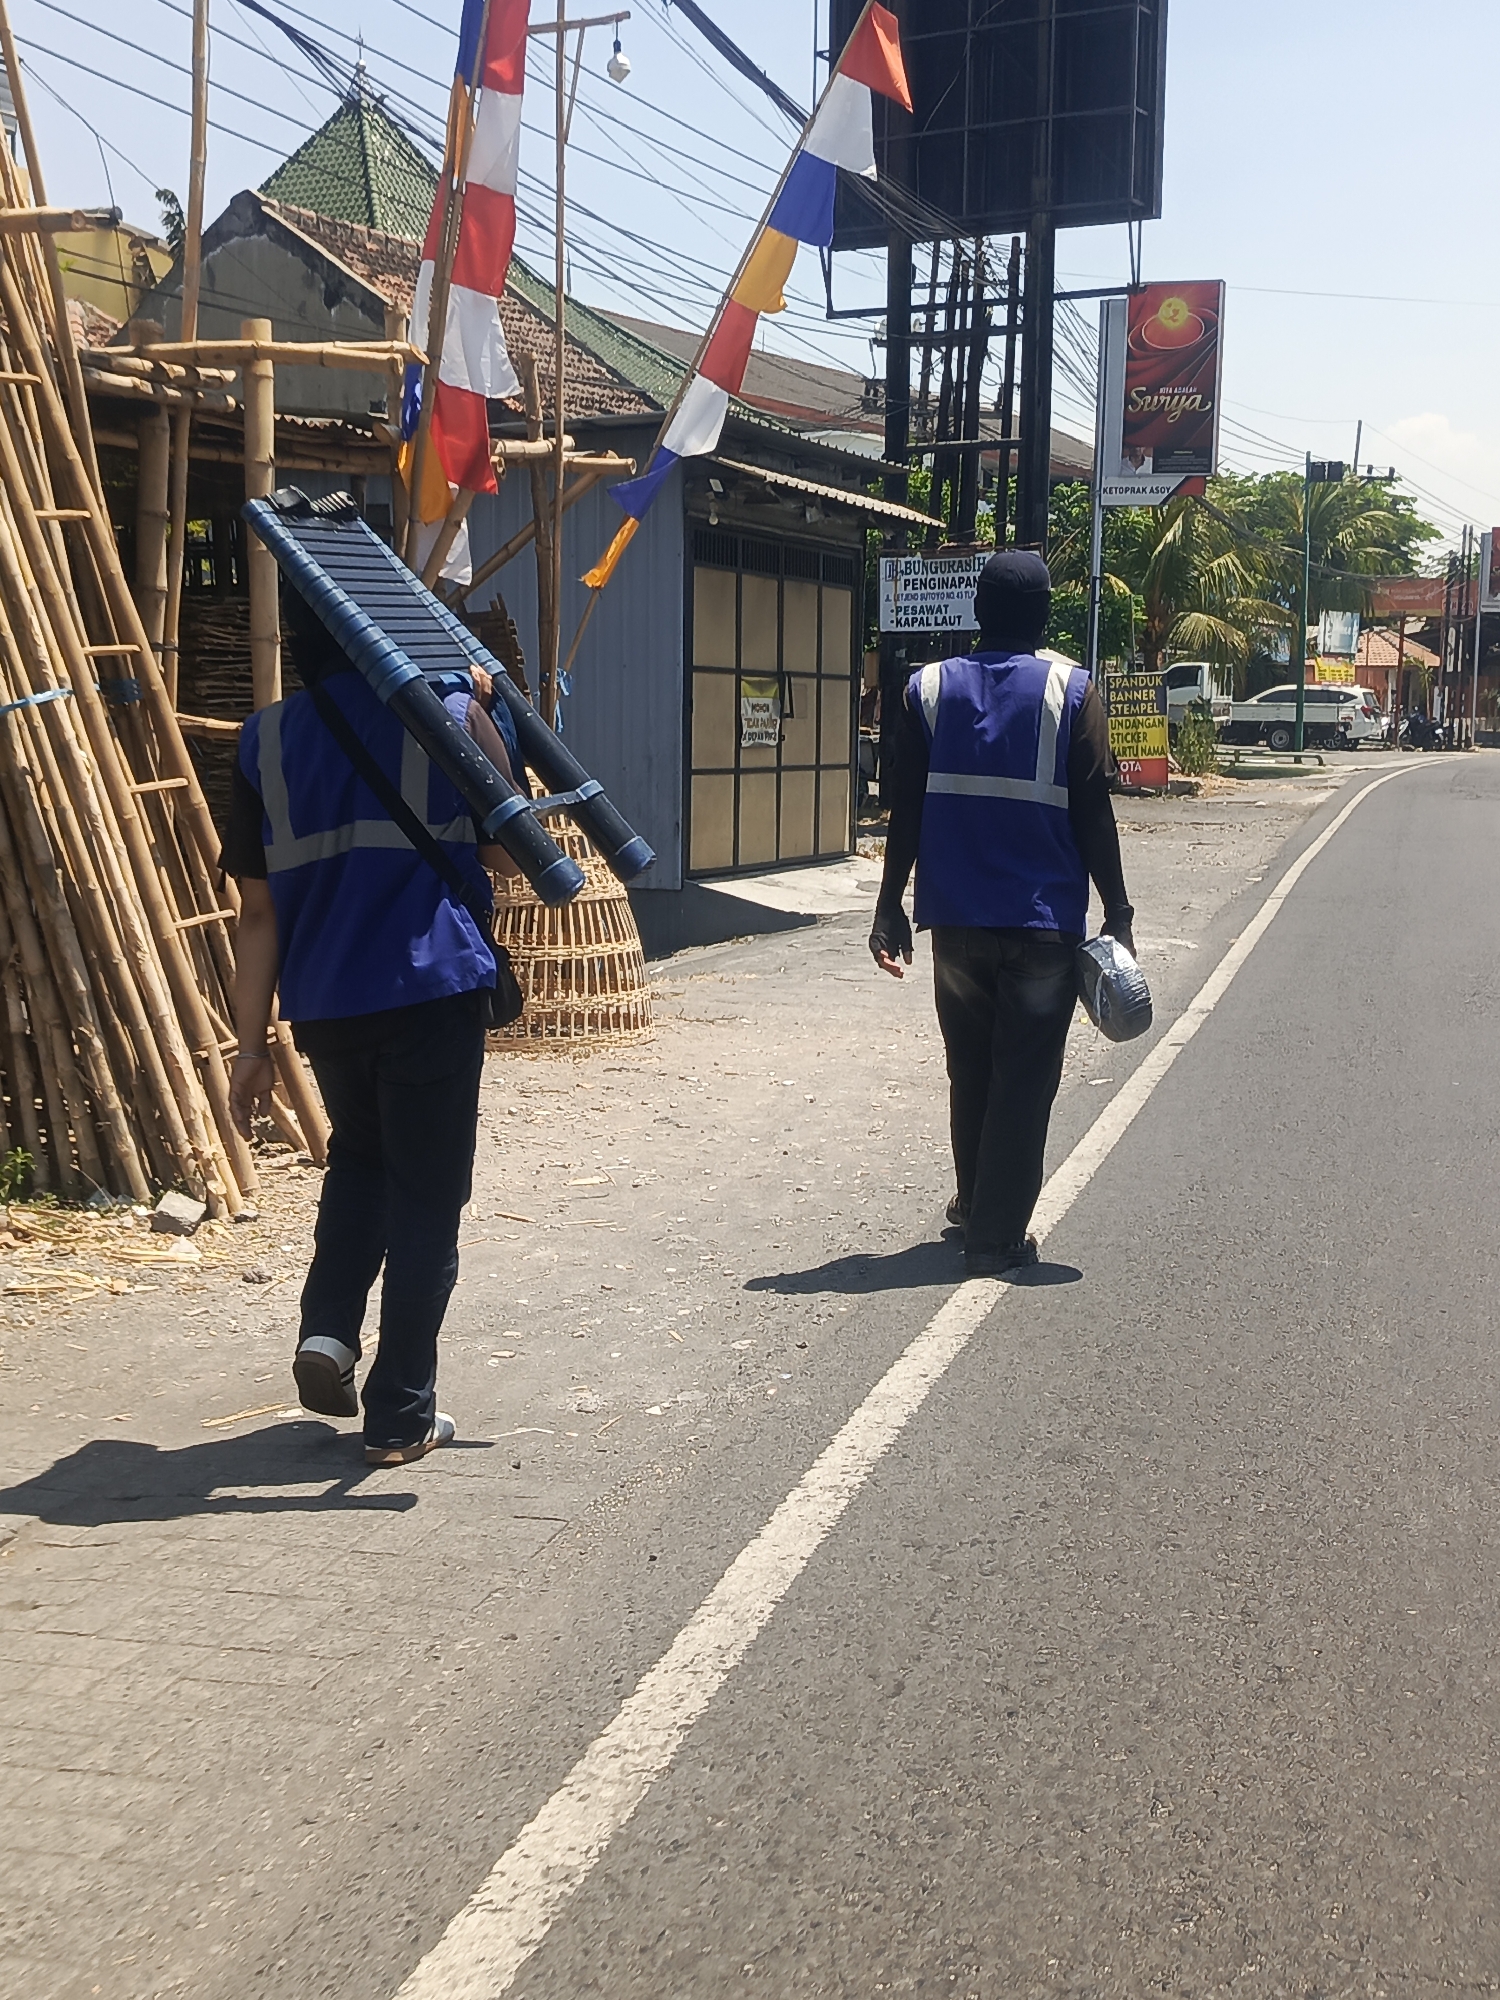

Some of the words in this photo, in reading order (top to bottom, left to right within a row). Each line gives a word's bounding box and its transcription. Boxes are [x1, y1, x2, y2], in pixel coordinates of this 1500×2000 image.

[1128, 386, 1212, 423] Surya
[1103, 486, 1147, 495] KETOPRAK
[1149, 486, 1171, 495] ASOY
[904, 557, 986, 576] BUNGURASIH
[896, 604, 949, 616] PESAWAT
[895, 616, 932, 628] KAPAL
[934, 615, 962, 627] LAUT
[1109, 675, 1163, 688] SPANDUK
[1109, 689, 1156, 702] BANNER
[1109, 702, 1160, 715] STEMPEL
[1110, 717, 1165, 730] UNDANGAN
[1110, 731, 1148, 744] STICKER
[1141, 745, 1166, 757] NAMA
[1117, 760, 1142, 772] OTA
[1117, 774, 1133, 785] LL
